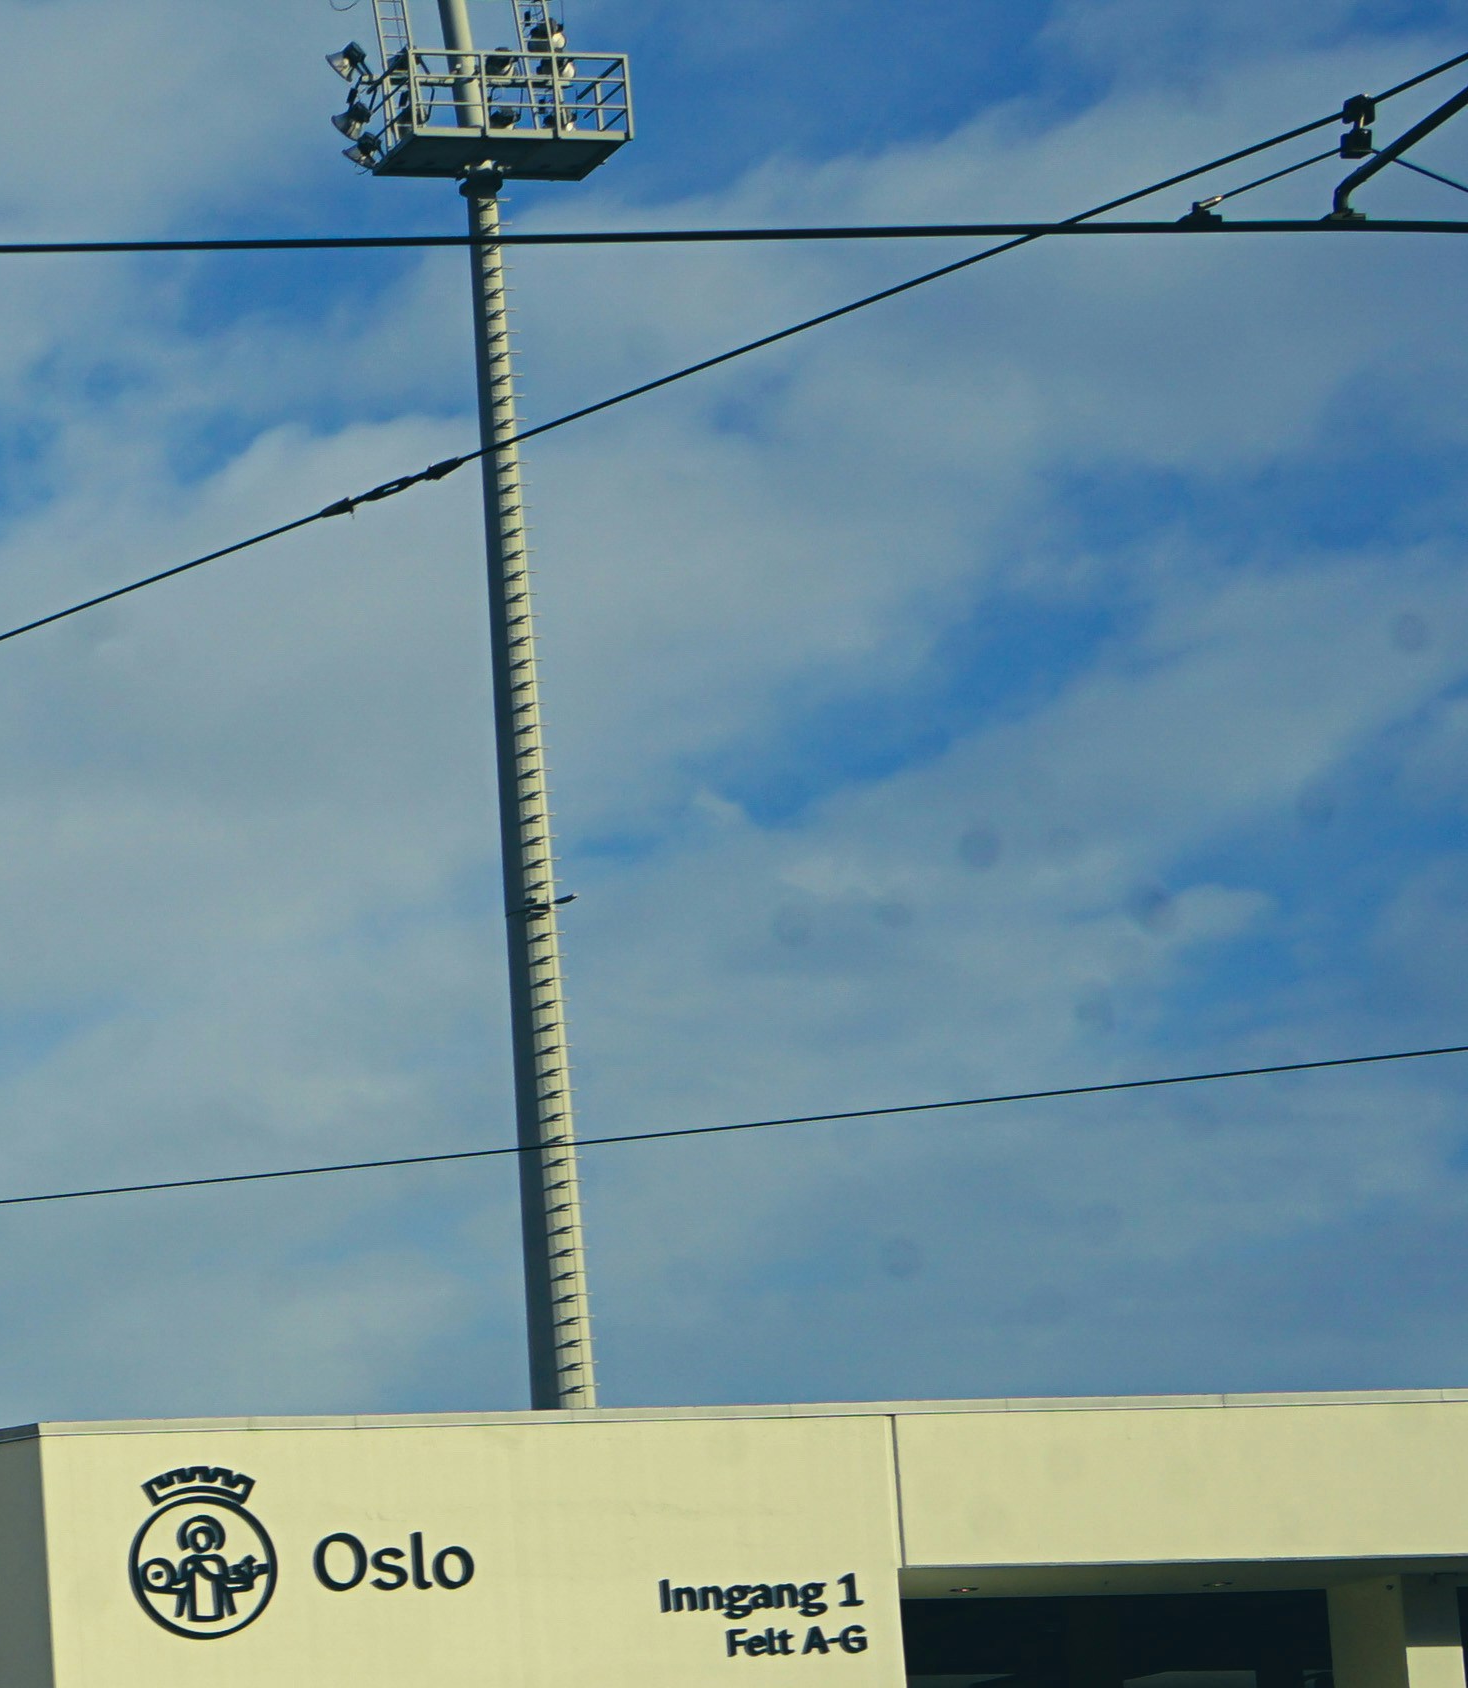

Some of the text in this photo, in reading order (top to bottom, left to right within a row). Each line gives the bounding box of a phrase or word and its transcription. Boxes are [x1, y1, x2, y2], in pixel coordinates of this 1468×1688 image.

[313, 1531, 475, 1592] Oslo
[658, 1573, 865, 1619] Inngang 1
[725, 1625, 868, 1658] Felt A-G
